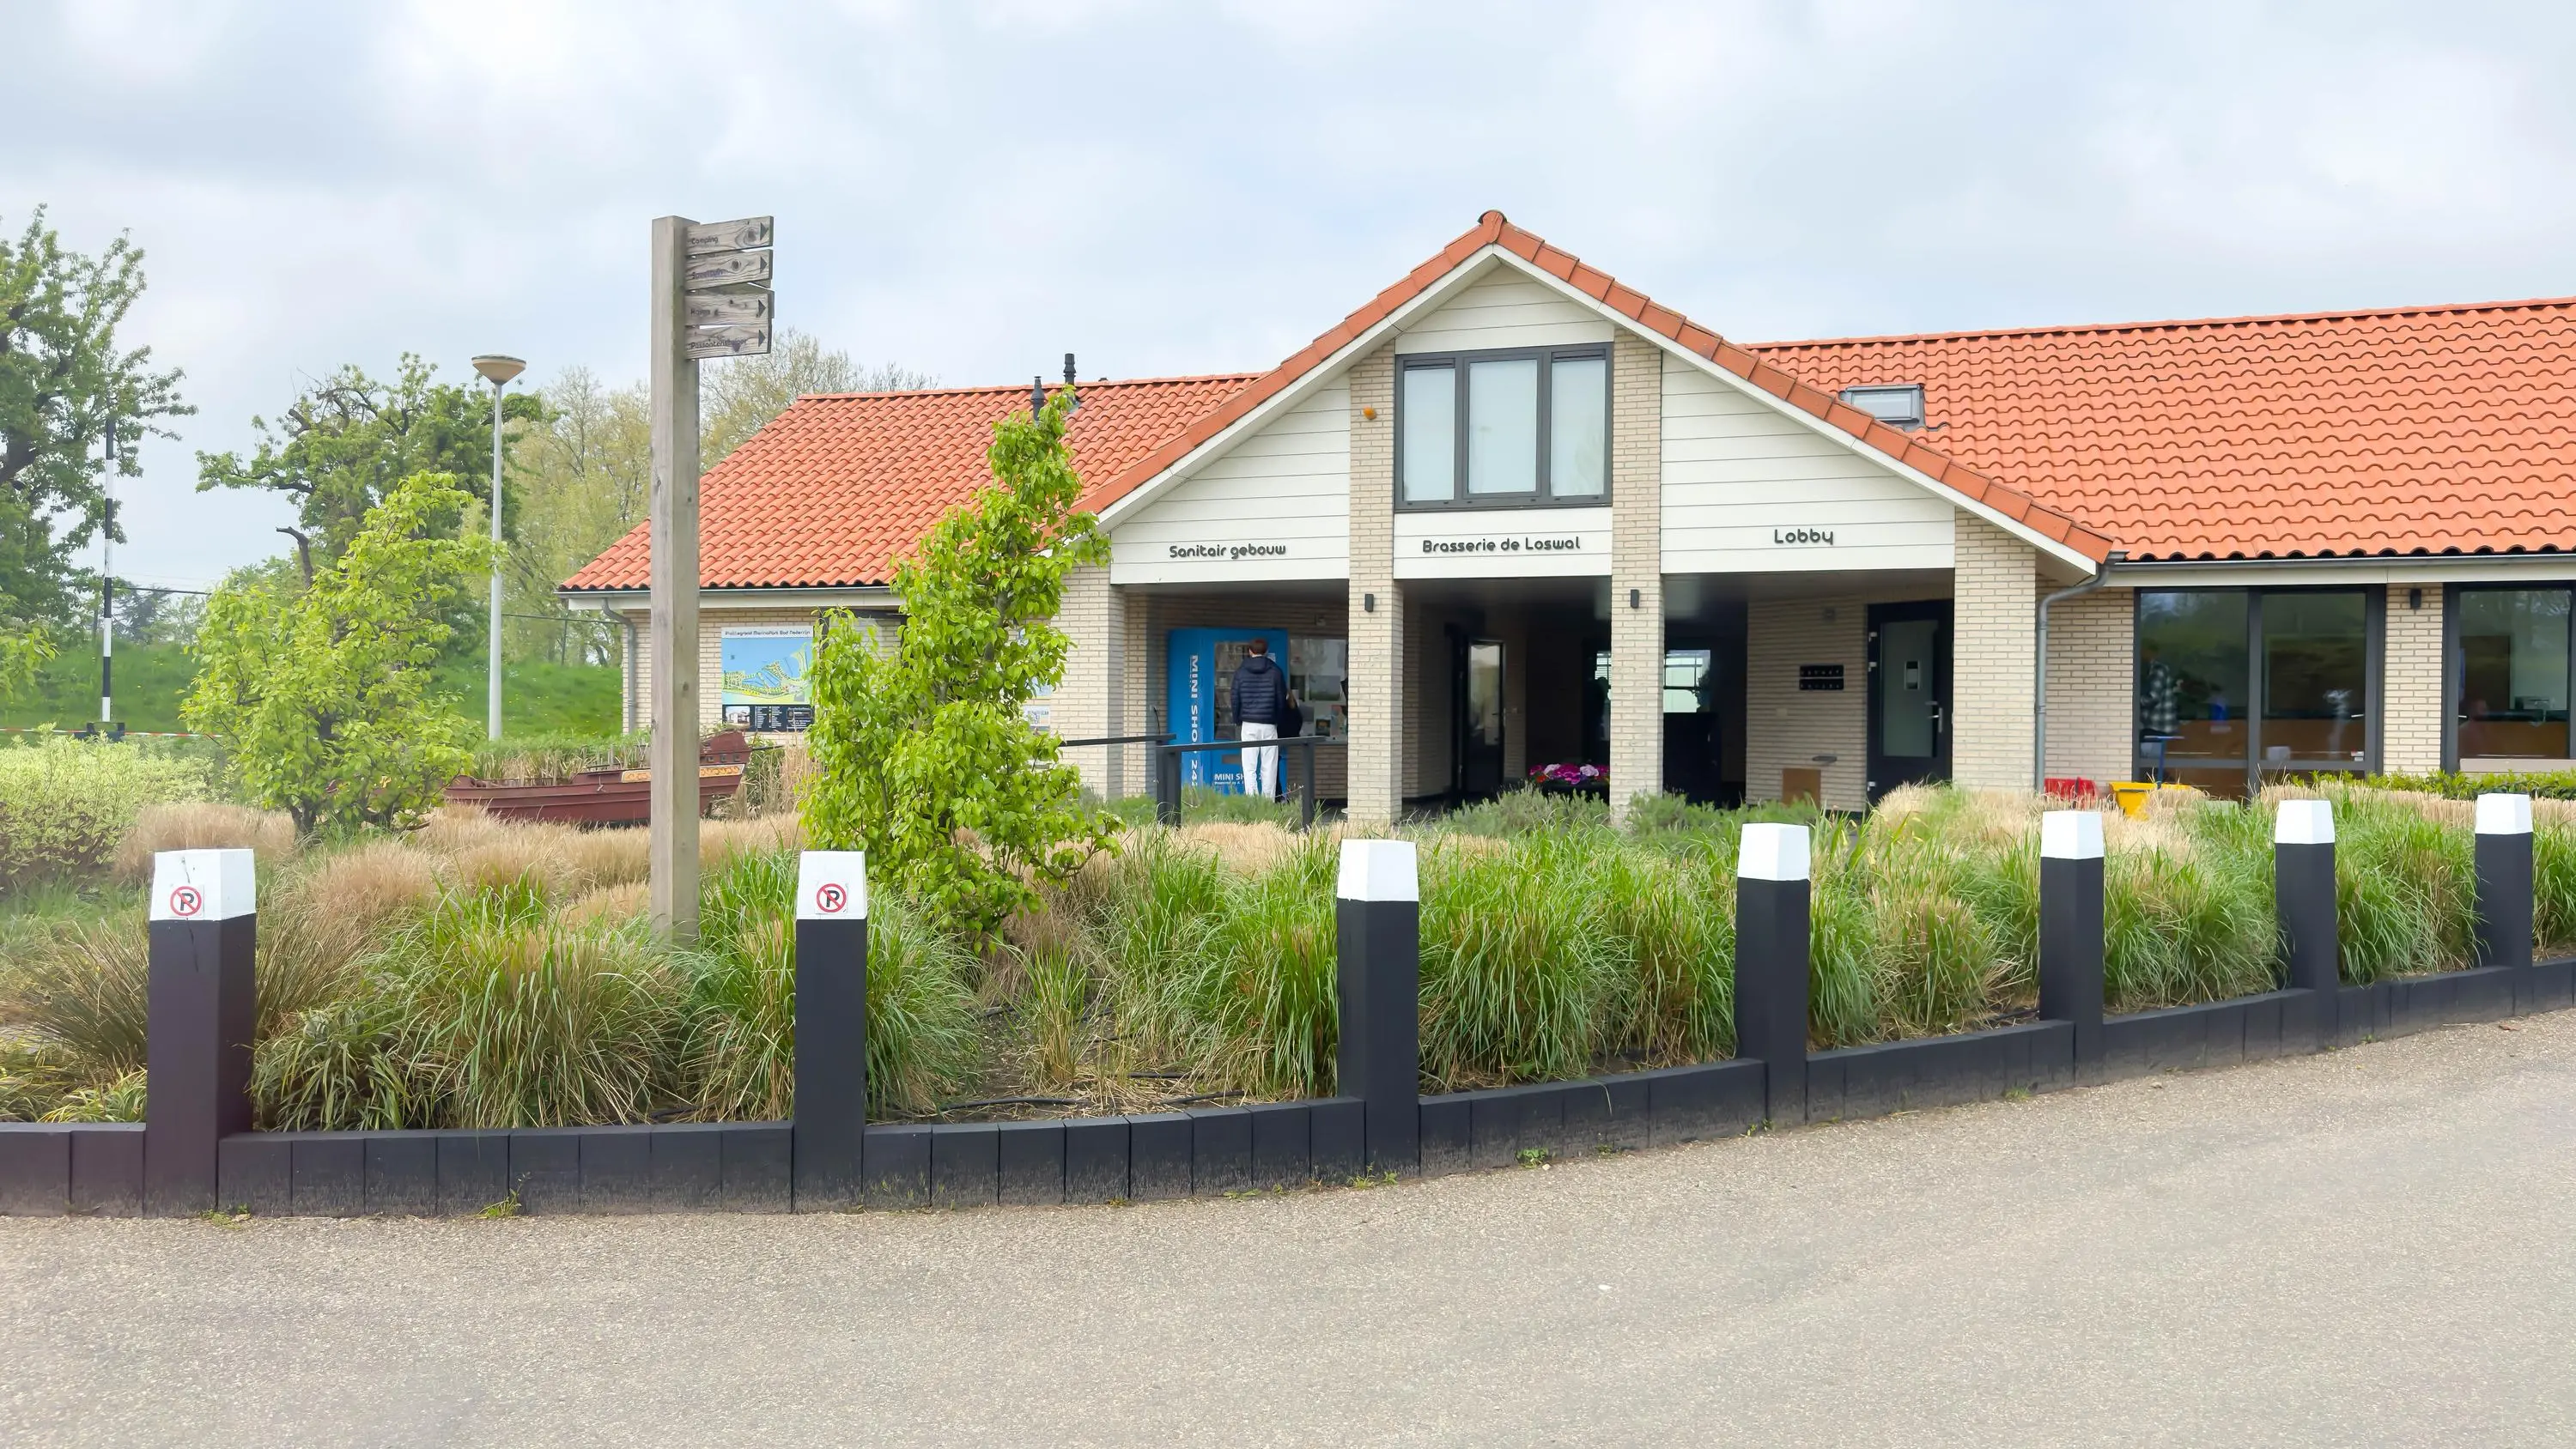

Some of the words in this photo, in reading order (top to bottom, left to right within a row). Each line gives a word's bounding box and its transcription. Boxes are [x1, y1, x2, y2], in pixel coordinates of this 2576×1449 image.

[691, 235, 719, 245] Camping
[1422, 538, 1496, 553] Brasserie
[1500, 537, 1520, 551] de
[1525, 536, 1581, 550] Loswal
[1774, 528, 1833, 545] Lobby
[1169, 544, 1227, 558] Sanitair
[1230, 543, 1286, 560] gebouw
